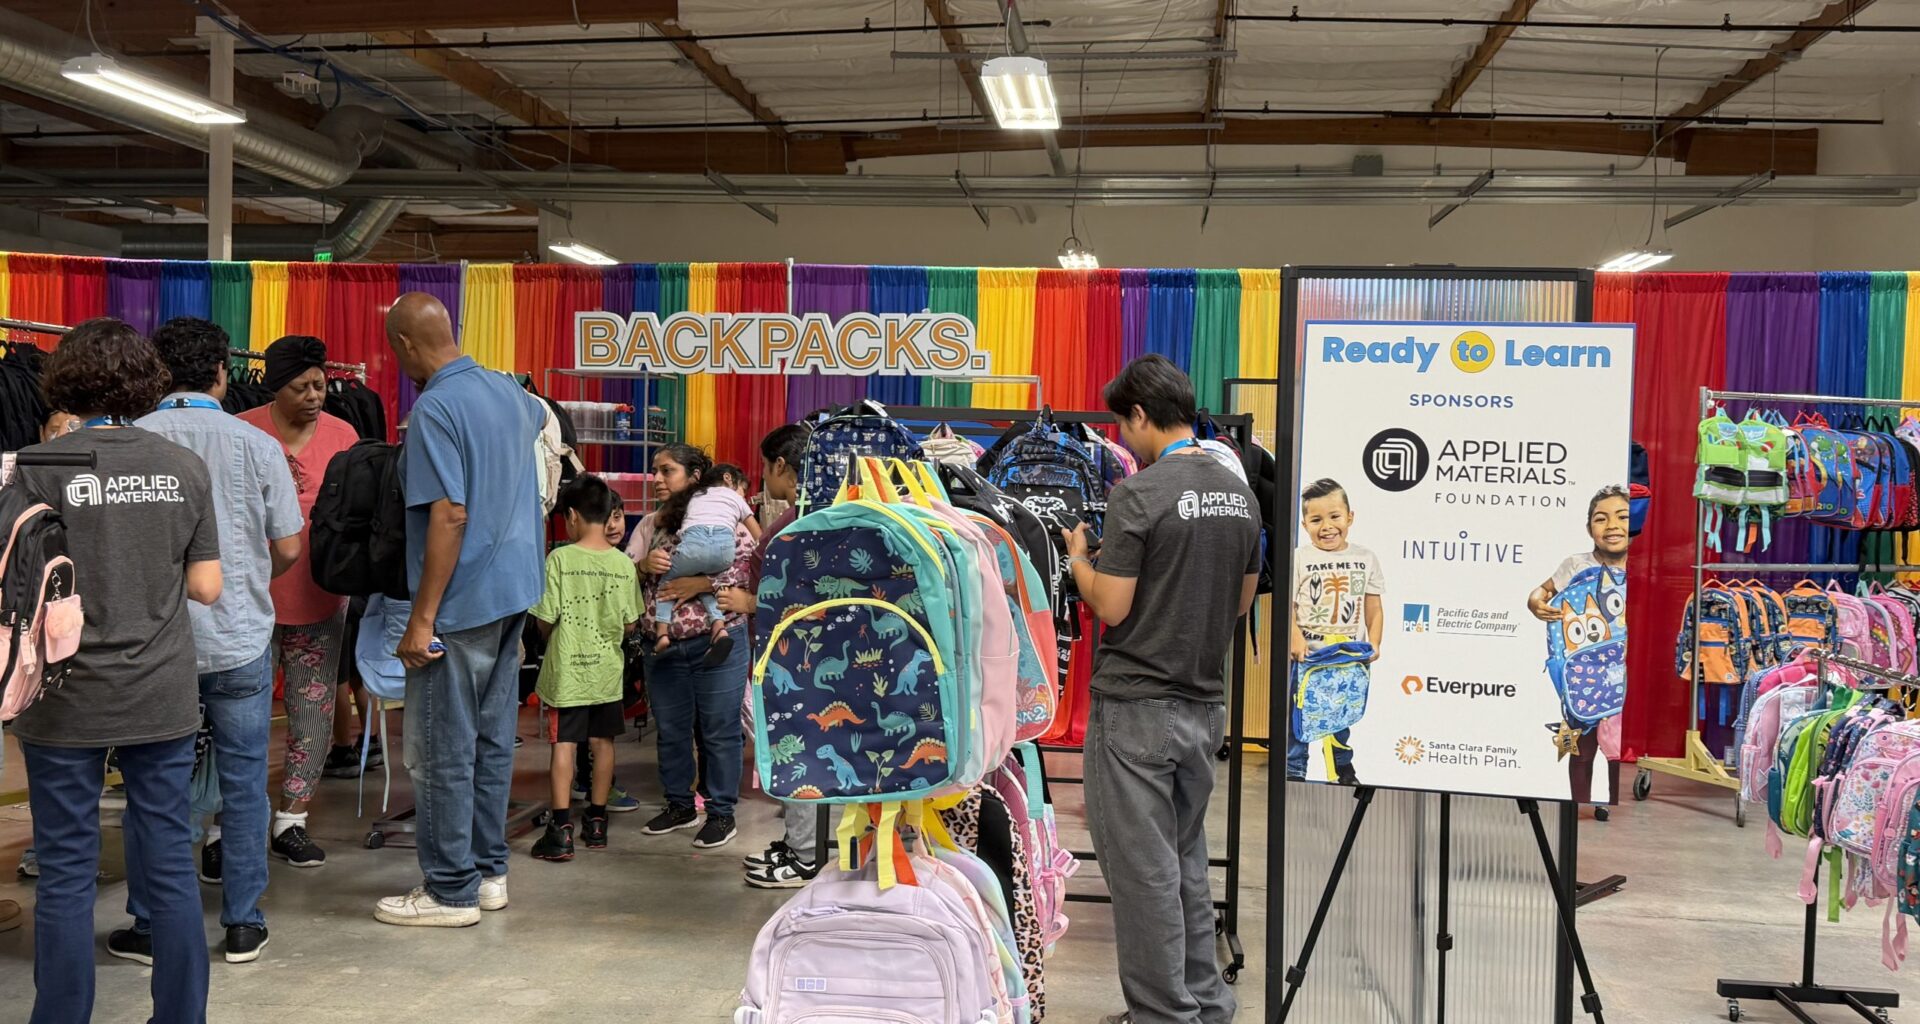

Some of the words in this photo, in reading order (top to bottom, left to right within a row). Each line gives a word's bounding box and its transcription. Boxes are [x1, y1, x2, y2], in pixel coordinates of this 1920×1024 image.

[579, 316, 986, 369] BACKPACKS.
[1322, 336, 1440, 373] Ready
[1457, 340, 1488, 362] to
[1504, 340, 1611, 368] Learn
[1409, 394, 1514, 409] SPONSORS
[1437, 440, 1567, 464] APPLIED
[105, 475, 180, 491] APPLIED
[1201, 492, 1248, 508] APPLIED
[1435, 493, 1566, 507] FOUNDATION
[1402, 531, 1524, 564] INTUITIVE
[1306, 563, 1334, 572] TAKE
[1336, 562, 1351, 570] ME
[1353, 562, 1366, 570] TO
[1437, 607, 1469, 619] Pacific
[1471, 609, 1489, 619] Gas
[1490, 611, 1509, 620] and
[1403, 621, 1430, 632] PG&E
[1436, 618, 1473, 630] Electric
[1474, 620, 1518, 633] Company
[1426, 676, 1517, 699] Everpure
[1428, 741, 1456, 751] Santa
[1458, 743, 1483, 753] Clara
[1485, 745, 1518, 756] Family
[1428, 751, 1478, 766] Health
